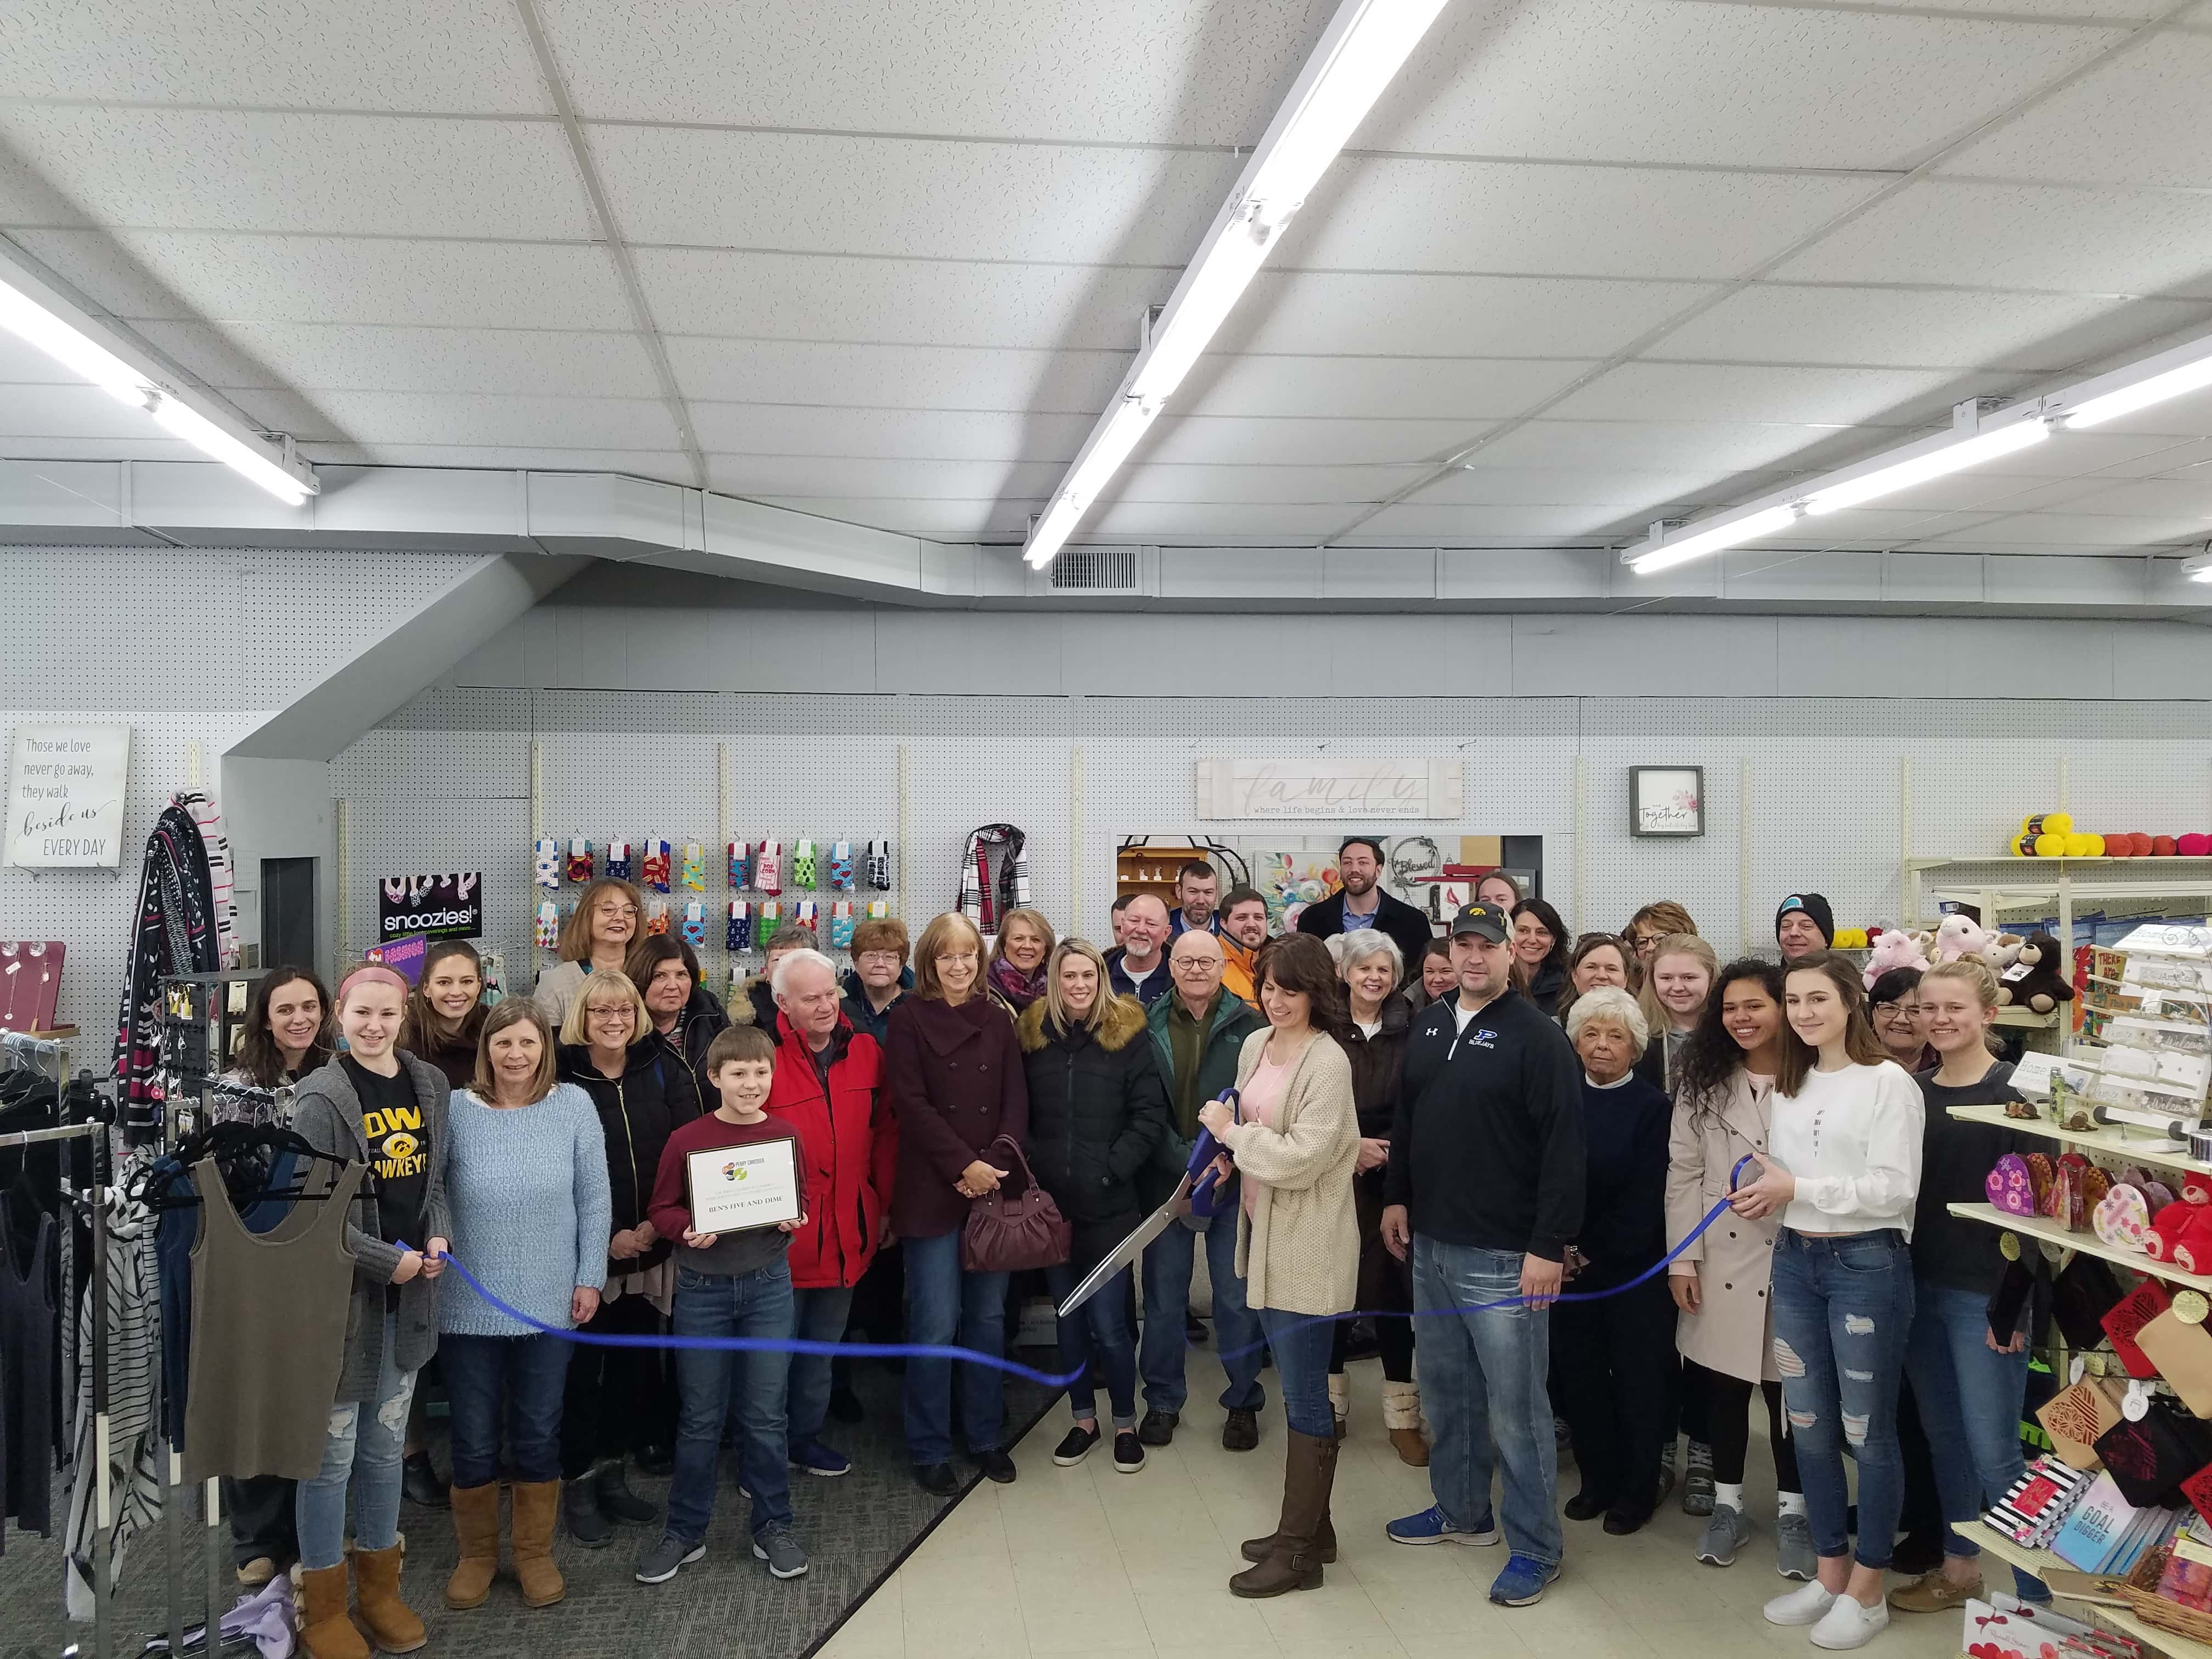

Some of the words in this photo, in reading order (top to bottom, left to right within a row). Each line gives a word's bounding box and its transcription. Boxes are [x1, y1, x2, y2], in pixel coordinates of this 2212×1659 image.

[26, 738, 53, 752] Those
[56, 743, 68, 752] we
[71, 738, 91, 752] love
[24, 764, 53, 775] never
[54, 764, 65, 778] go
[67, 764, 94, 778] away,
[22, 784, 44, 802] they
[47, 784, 69, 798] walk
[1305, 806, 1336, 815] begins
[1639, 805, 1688, 828] Together
[18, 802, 75, 842] beside
[44, 839, 80, 855] EVERY
[83, 839, 106, 855] DAY
[1399, 854, 1435, 874] Blessed
[384, 905, 472, 931] snoozies!
[1474, 1029, 1498, 1040] P
[1469, 1039, 1494, 1049] BLUEJAYS
[2018, 1060, 2047, 1076] Home
[709, 1204, 729, 1213] BEN'S
[765, 1195, 783, 1204] DIME
[2100, 1500, 2109, 1510] BE
[2082, 1506, 2115, 1534] GOAL
[2074, 1520, 2106, 1545] DIGGER
